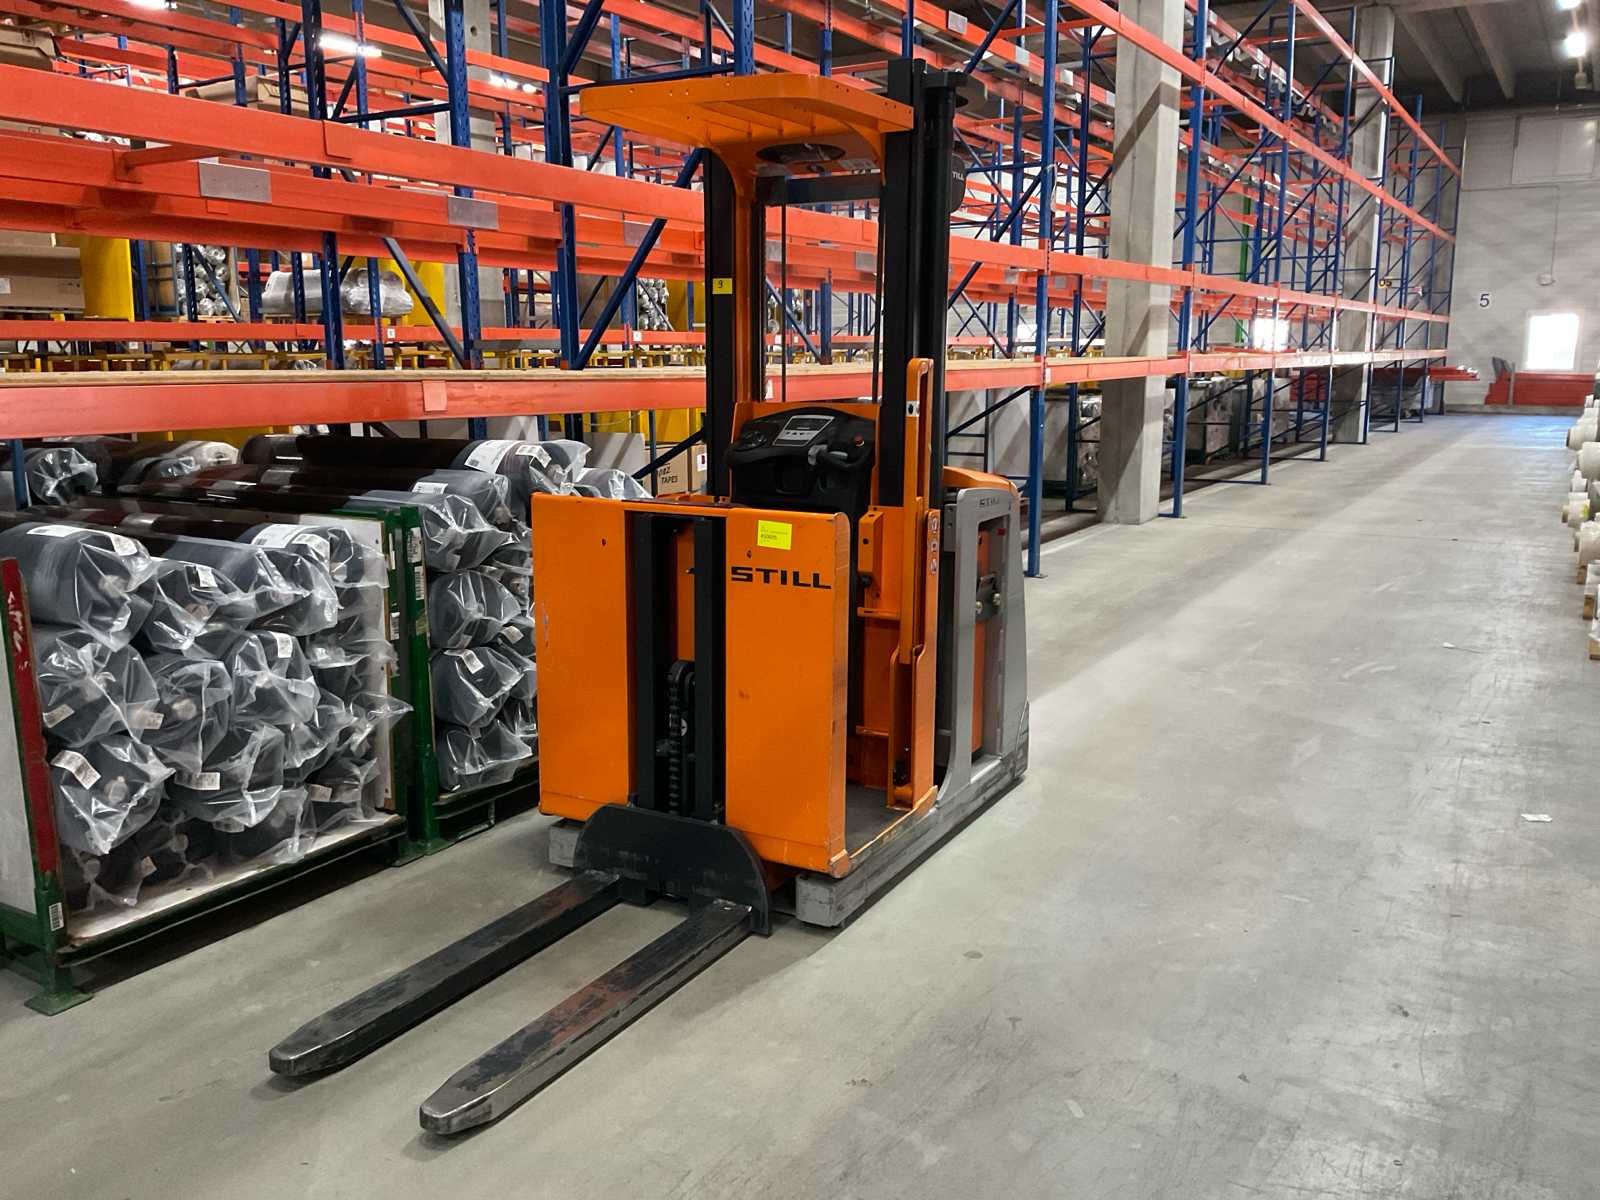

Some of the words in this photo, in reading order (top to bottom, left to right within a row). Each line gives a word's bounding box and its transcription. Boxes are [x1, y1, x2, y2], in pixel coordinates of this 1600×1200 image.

[952, 171, 965, 181] TILL
[1480, 293, 1489, 307] 5
[731, 566, 831, 589] STILL
